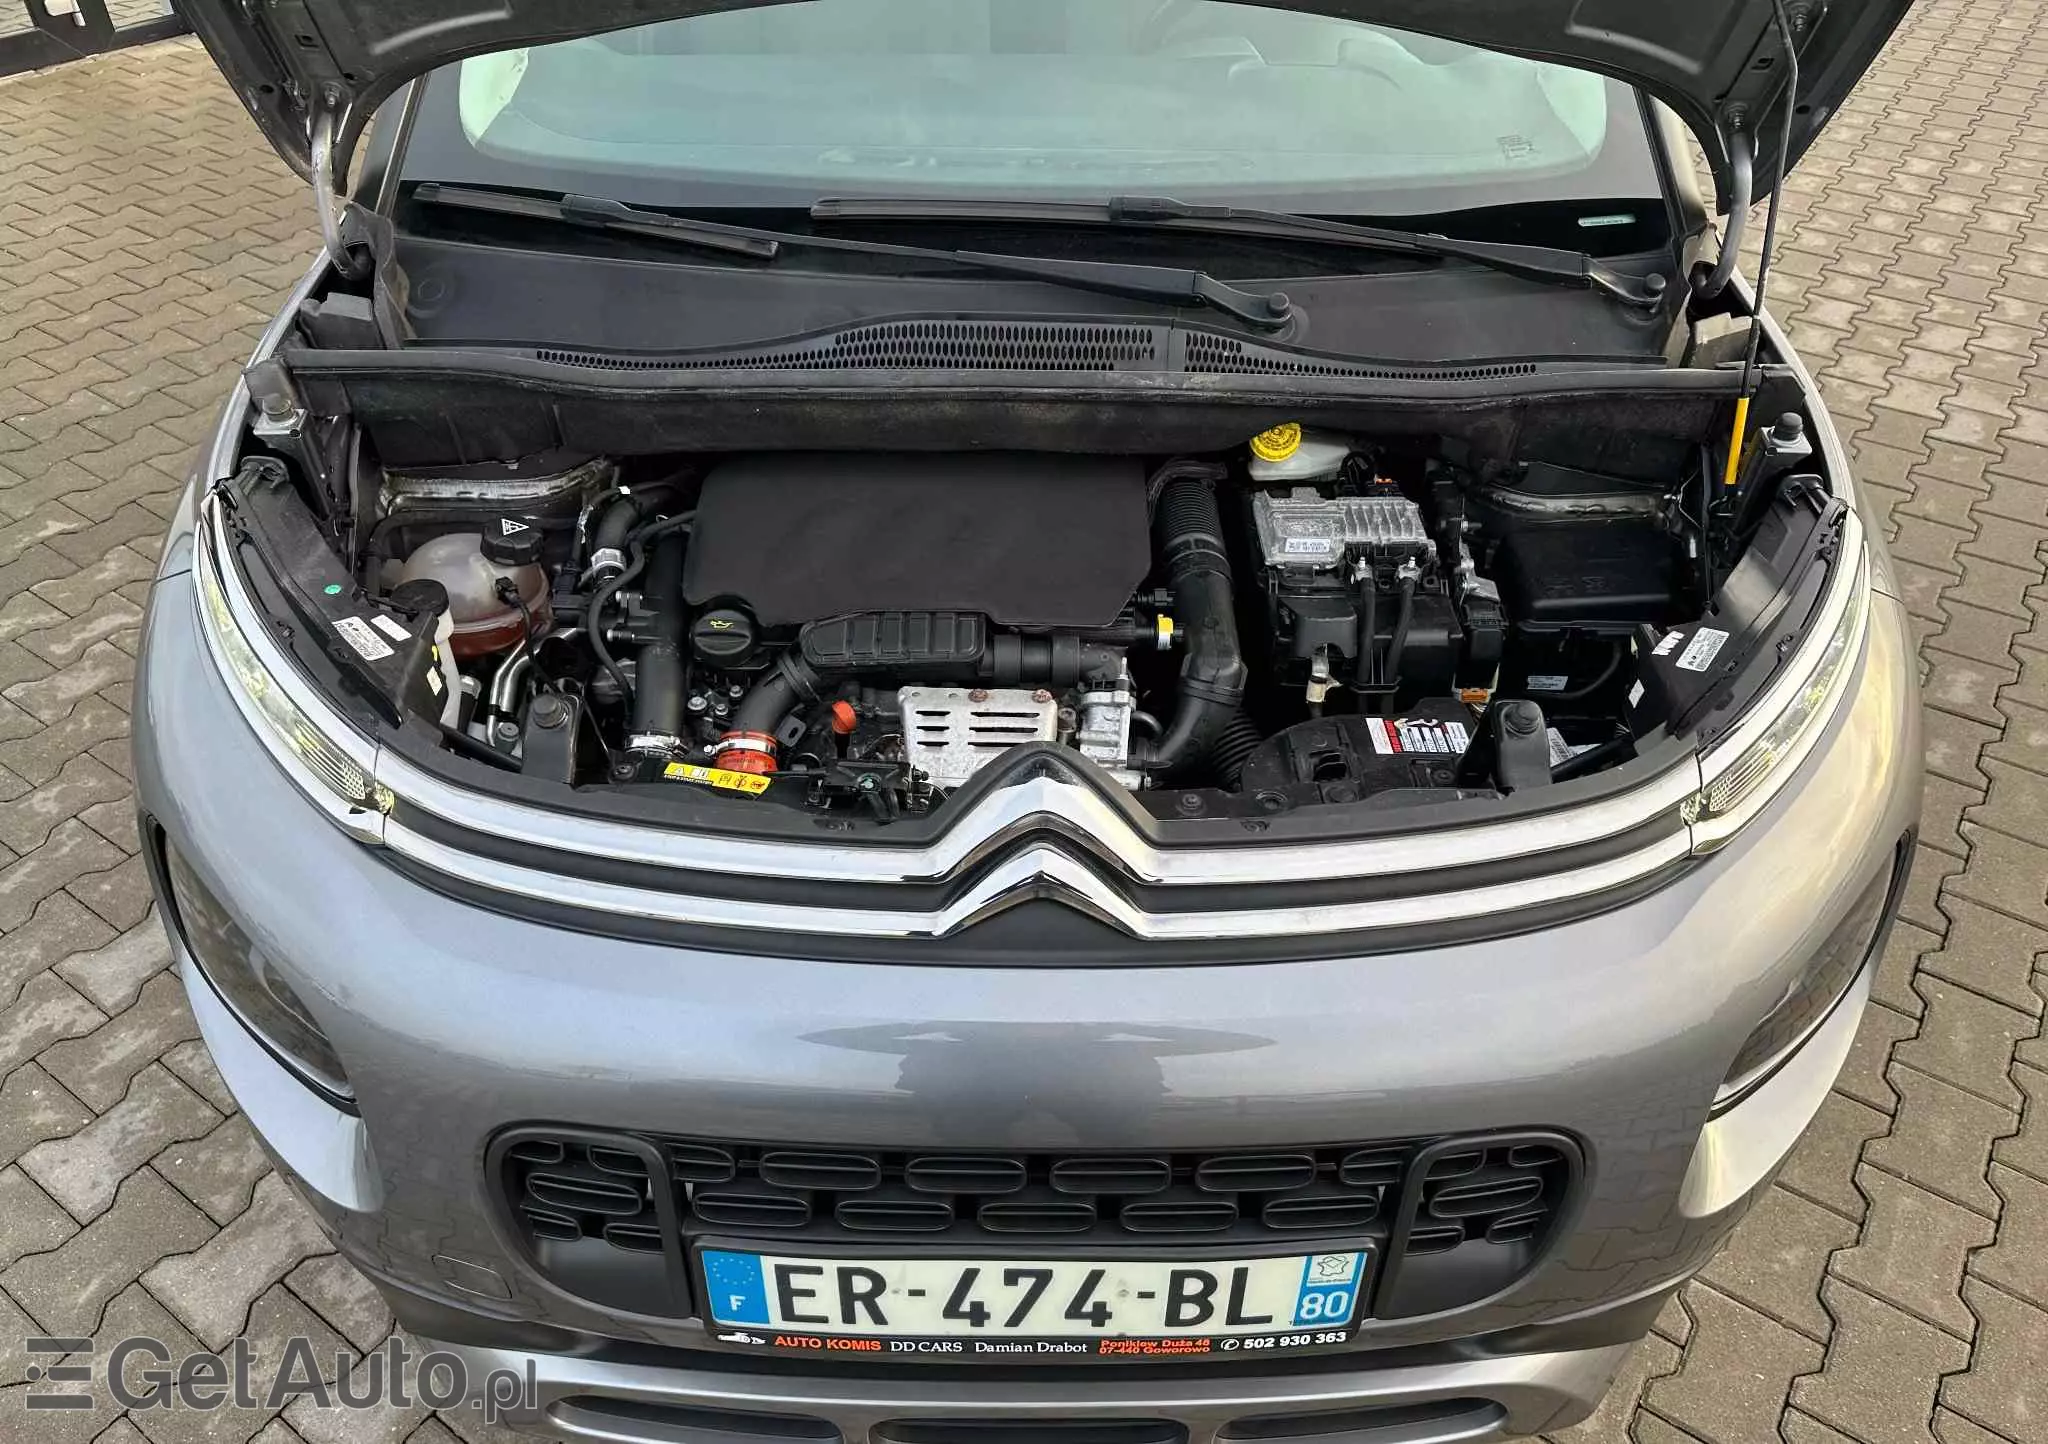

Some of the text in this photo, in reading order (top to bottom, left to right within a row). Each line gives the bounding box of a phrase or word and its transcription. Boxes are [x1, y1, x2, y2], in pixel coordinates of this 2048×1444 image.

[729, 1294, 747, 1312] F
[774, 1263, 1274, 1328] ER-474-BL
[1300, 1291, 1350, 1319] 80
[775, 1336, 1088, 1353] AUTO KOMIS DD CARS Damian Drabot
[1243, 1331, 1347, 1349] 502 930 363
